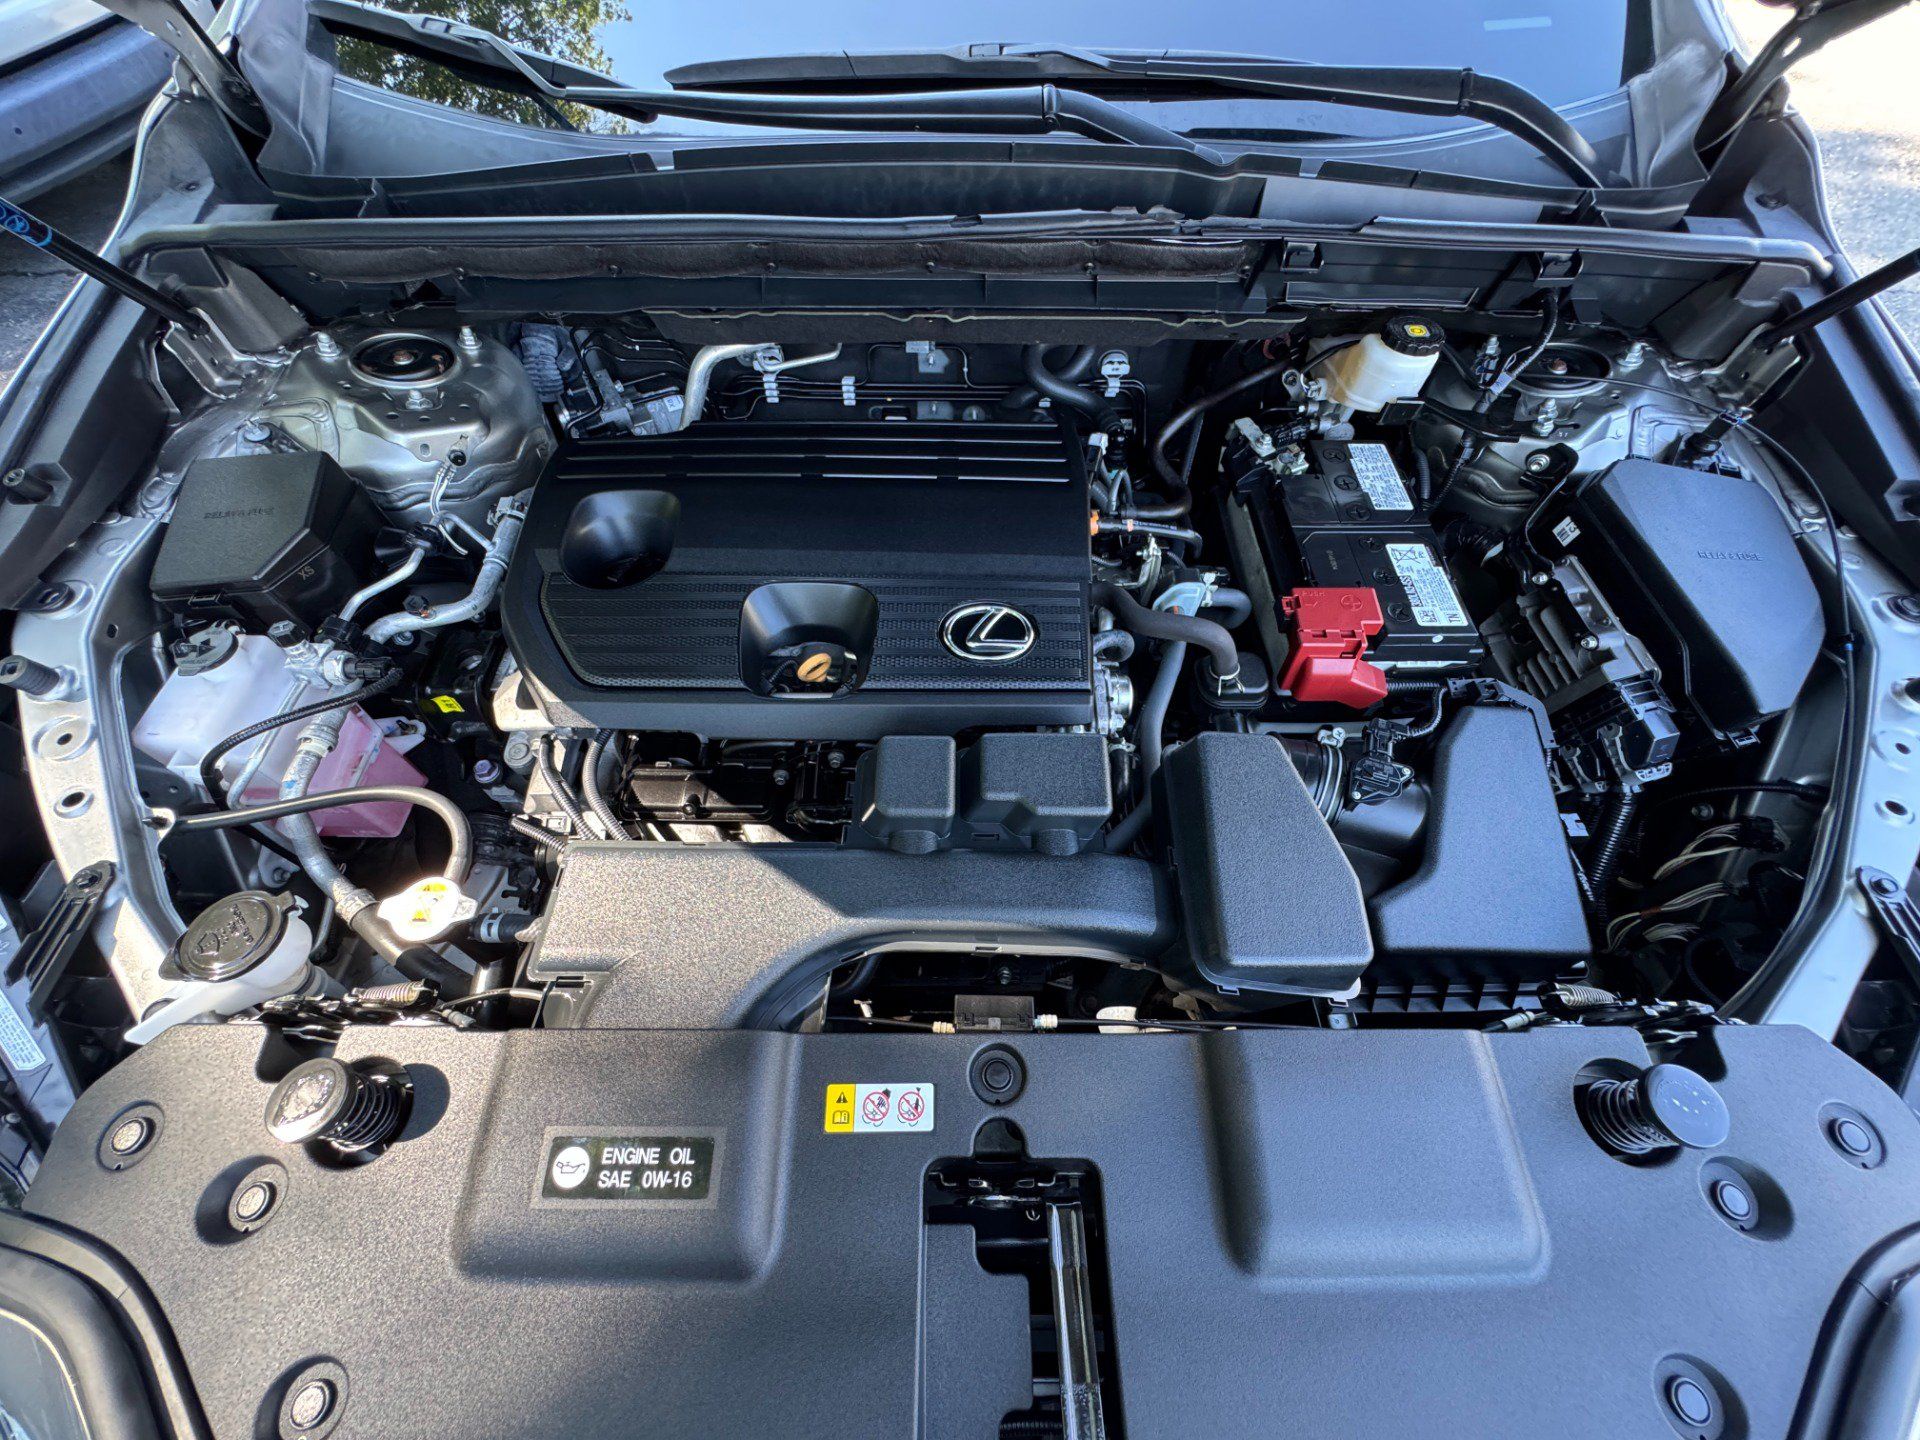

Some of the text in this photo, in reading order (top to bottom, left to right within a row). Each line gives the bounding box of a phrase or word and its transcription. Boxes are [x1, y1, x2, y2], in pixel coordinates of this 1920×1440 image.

[1446, 613, 1461, 623] TN
[601, 1147, 695, 1165] ENGINE OIL
[597, 1170, 692, 1189] SAE 0W-16
